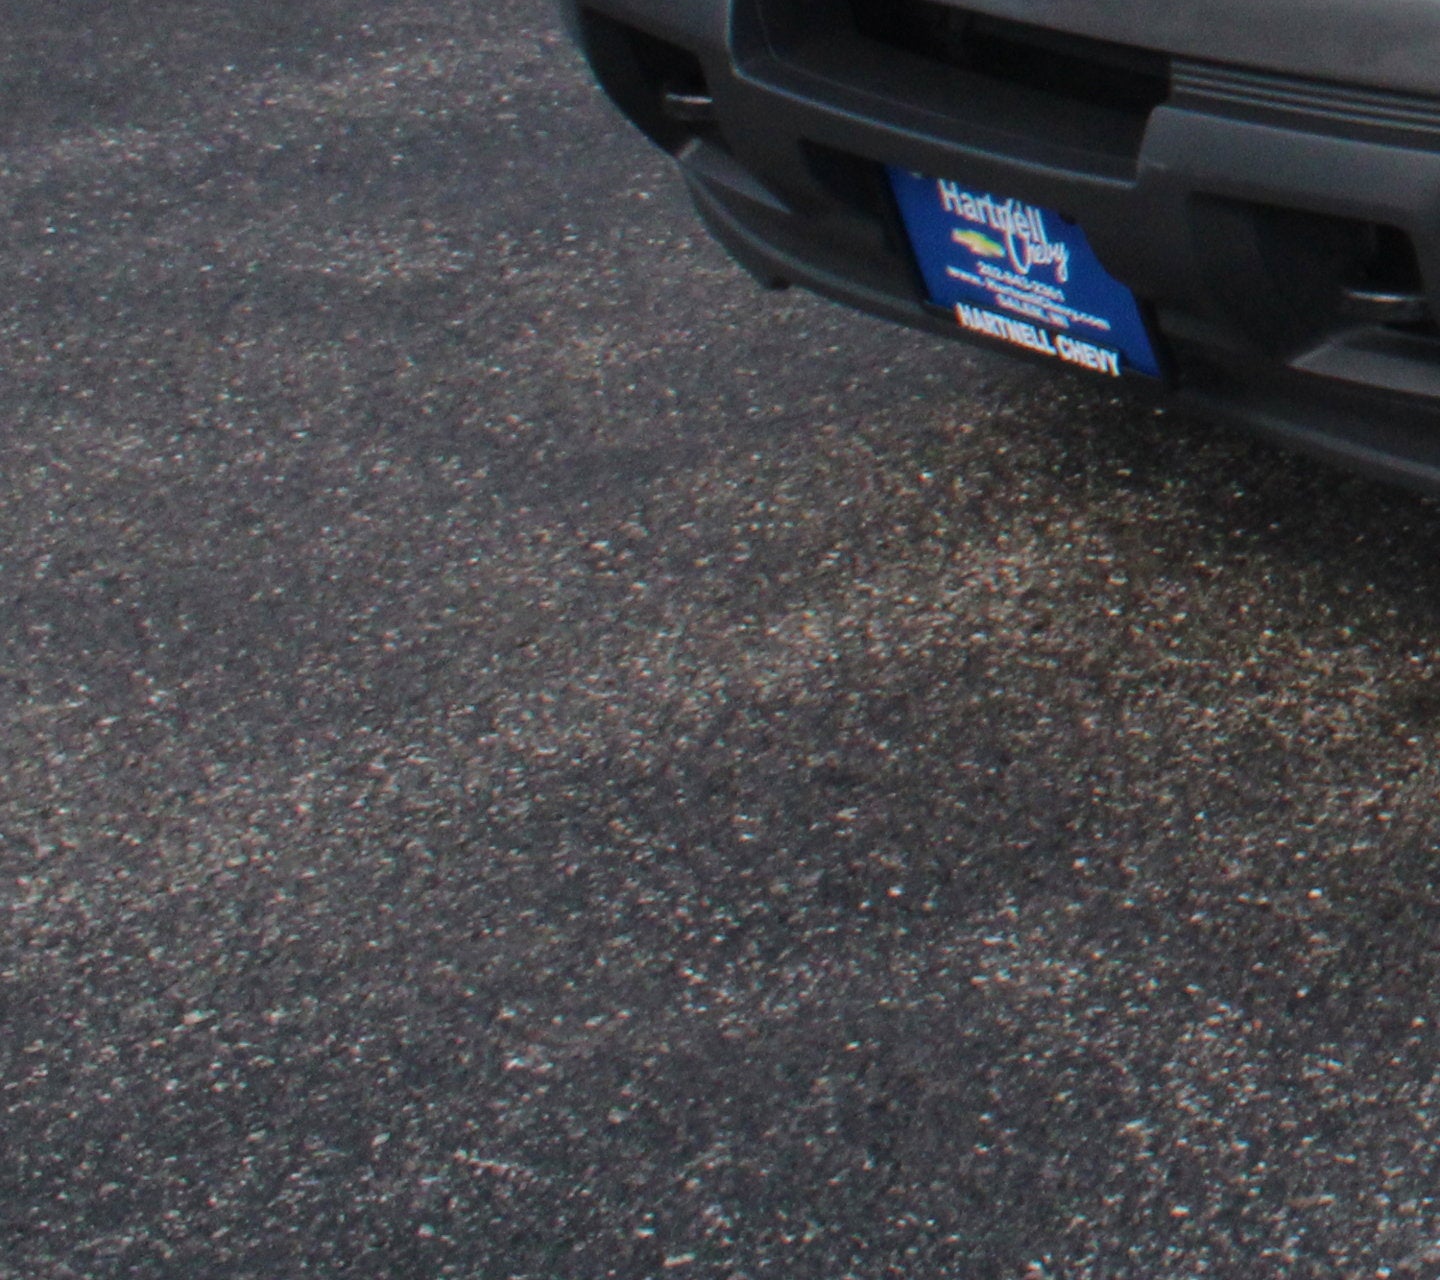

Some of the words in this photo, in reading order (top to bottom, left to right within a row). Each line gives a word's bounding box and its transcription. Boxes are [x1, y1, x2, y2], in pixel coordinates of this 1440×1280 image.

[937, 178, 1050, 244] Hartnell
[1005, 206, 1070, 282] Chevy
[955, 302, 1057, 356] HARTNELL
[1054, 335, 1120, 377] CHEVY
